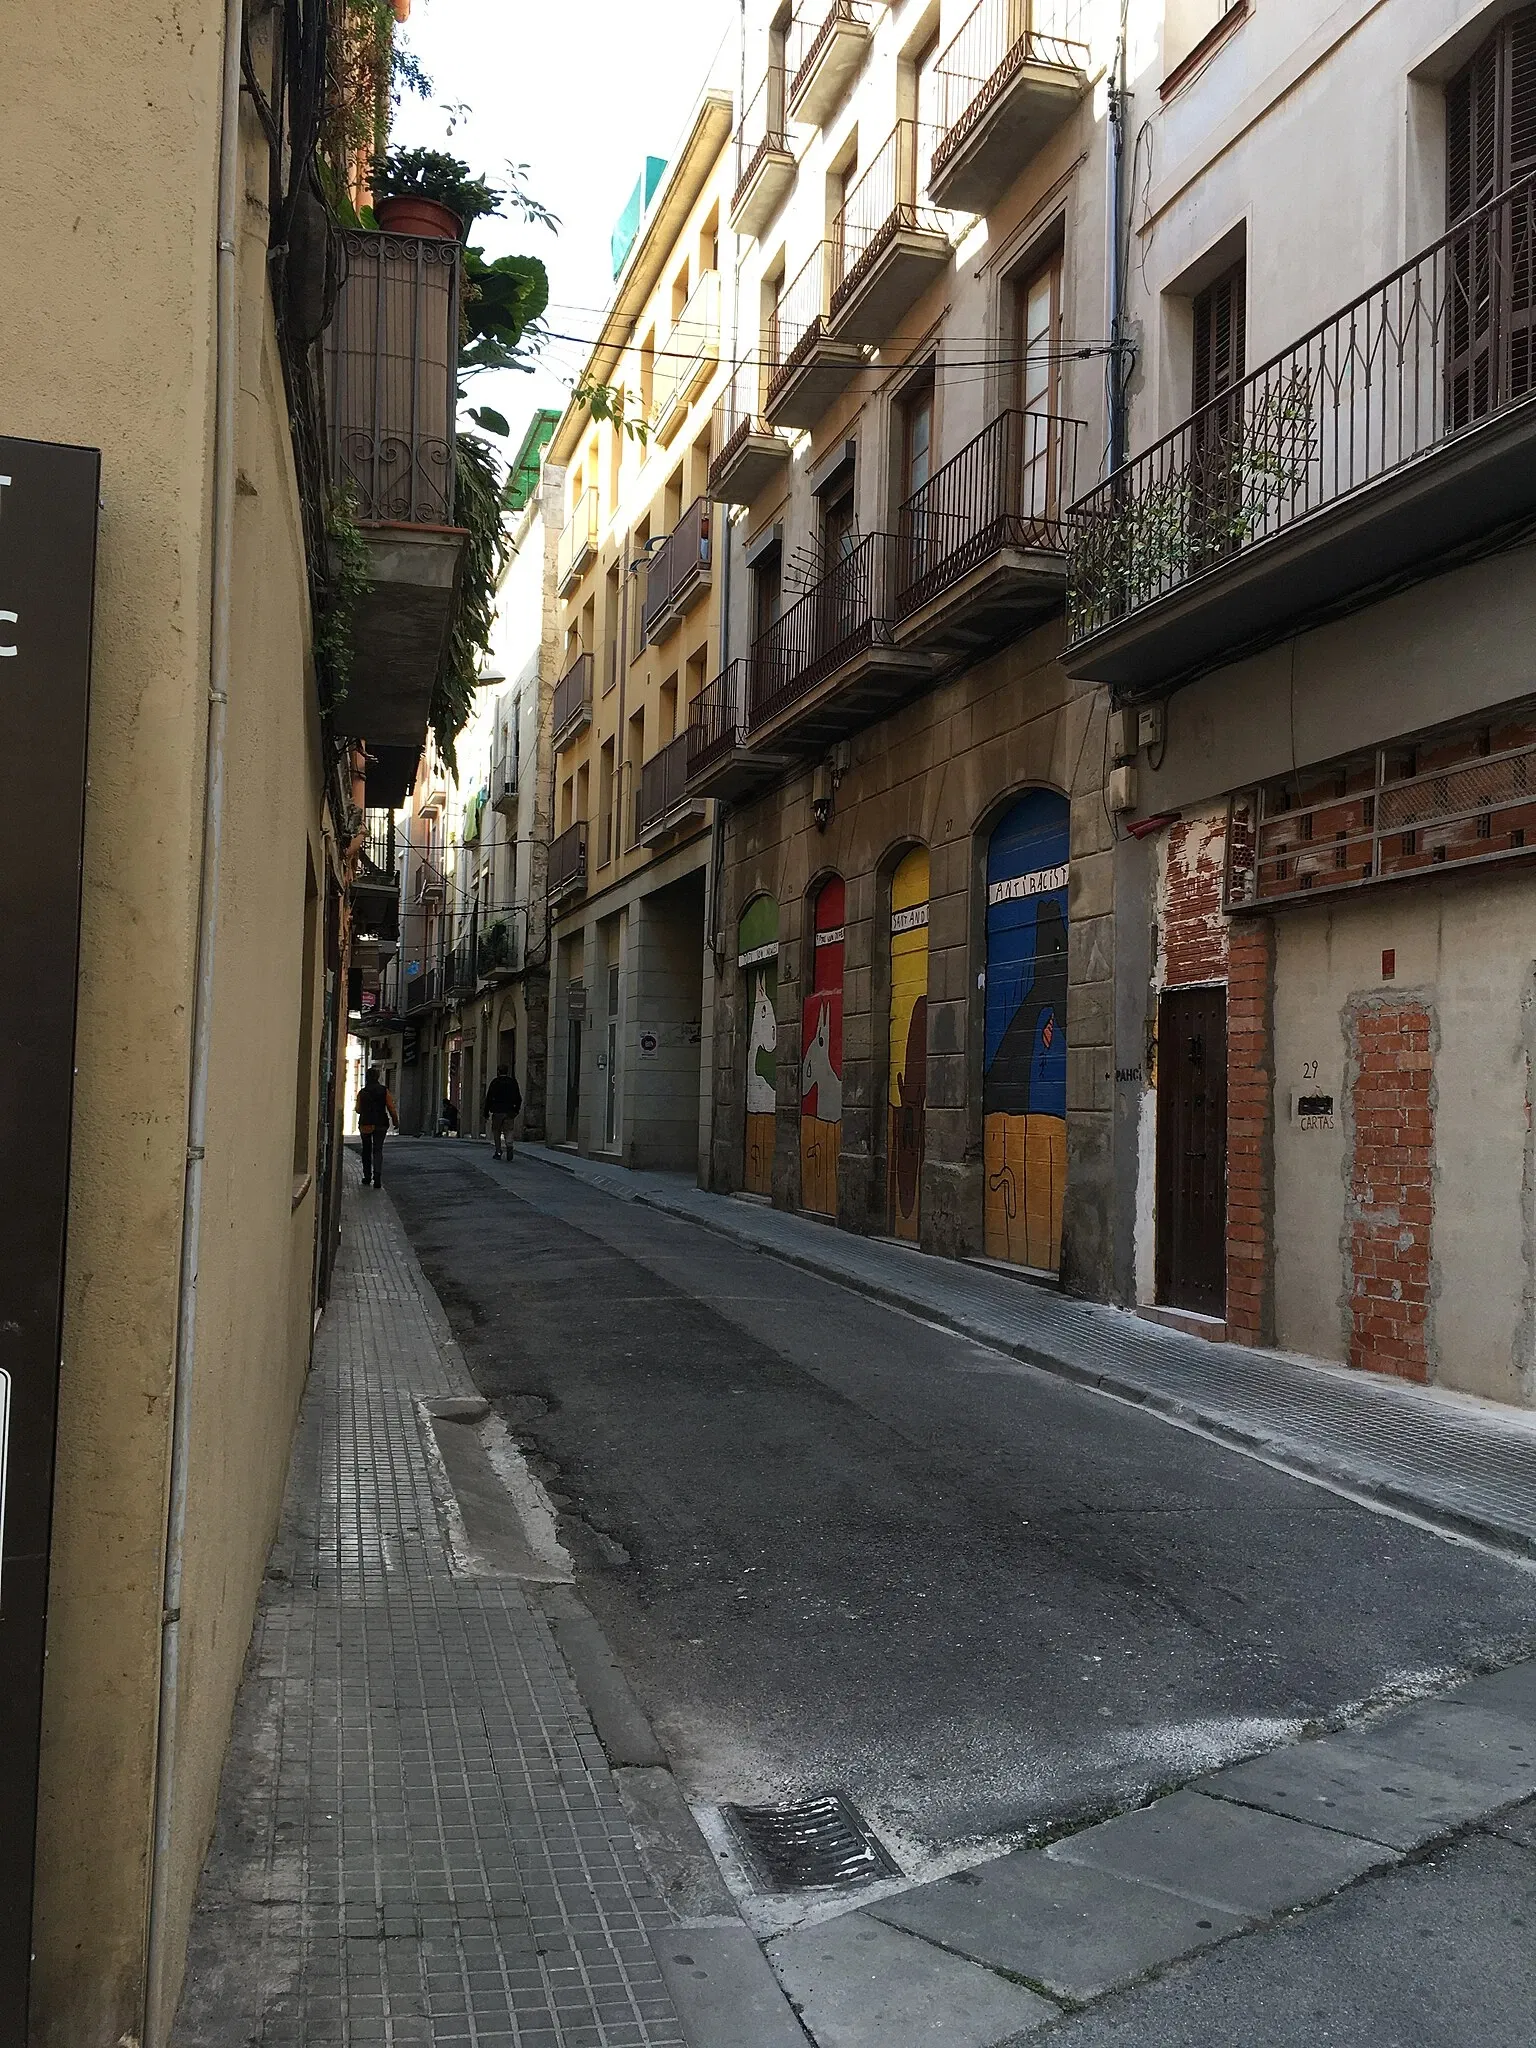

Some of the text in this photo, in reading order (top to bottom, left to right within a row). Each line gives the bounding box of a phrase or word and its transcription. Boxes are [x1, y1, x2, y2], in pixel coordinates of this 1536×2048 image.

[995, 867, 1070, 901] ANTiRACiST
[1303, 1060, 1319, 1079] 29
[1300, 1116, 1335, 1131] CARTAS
